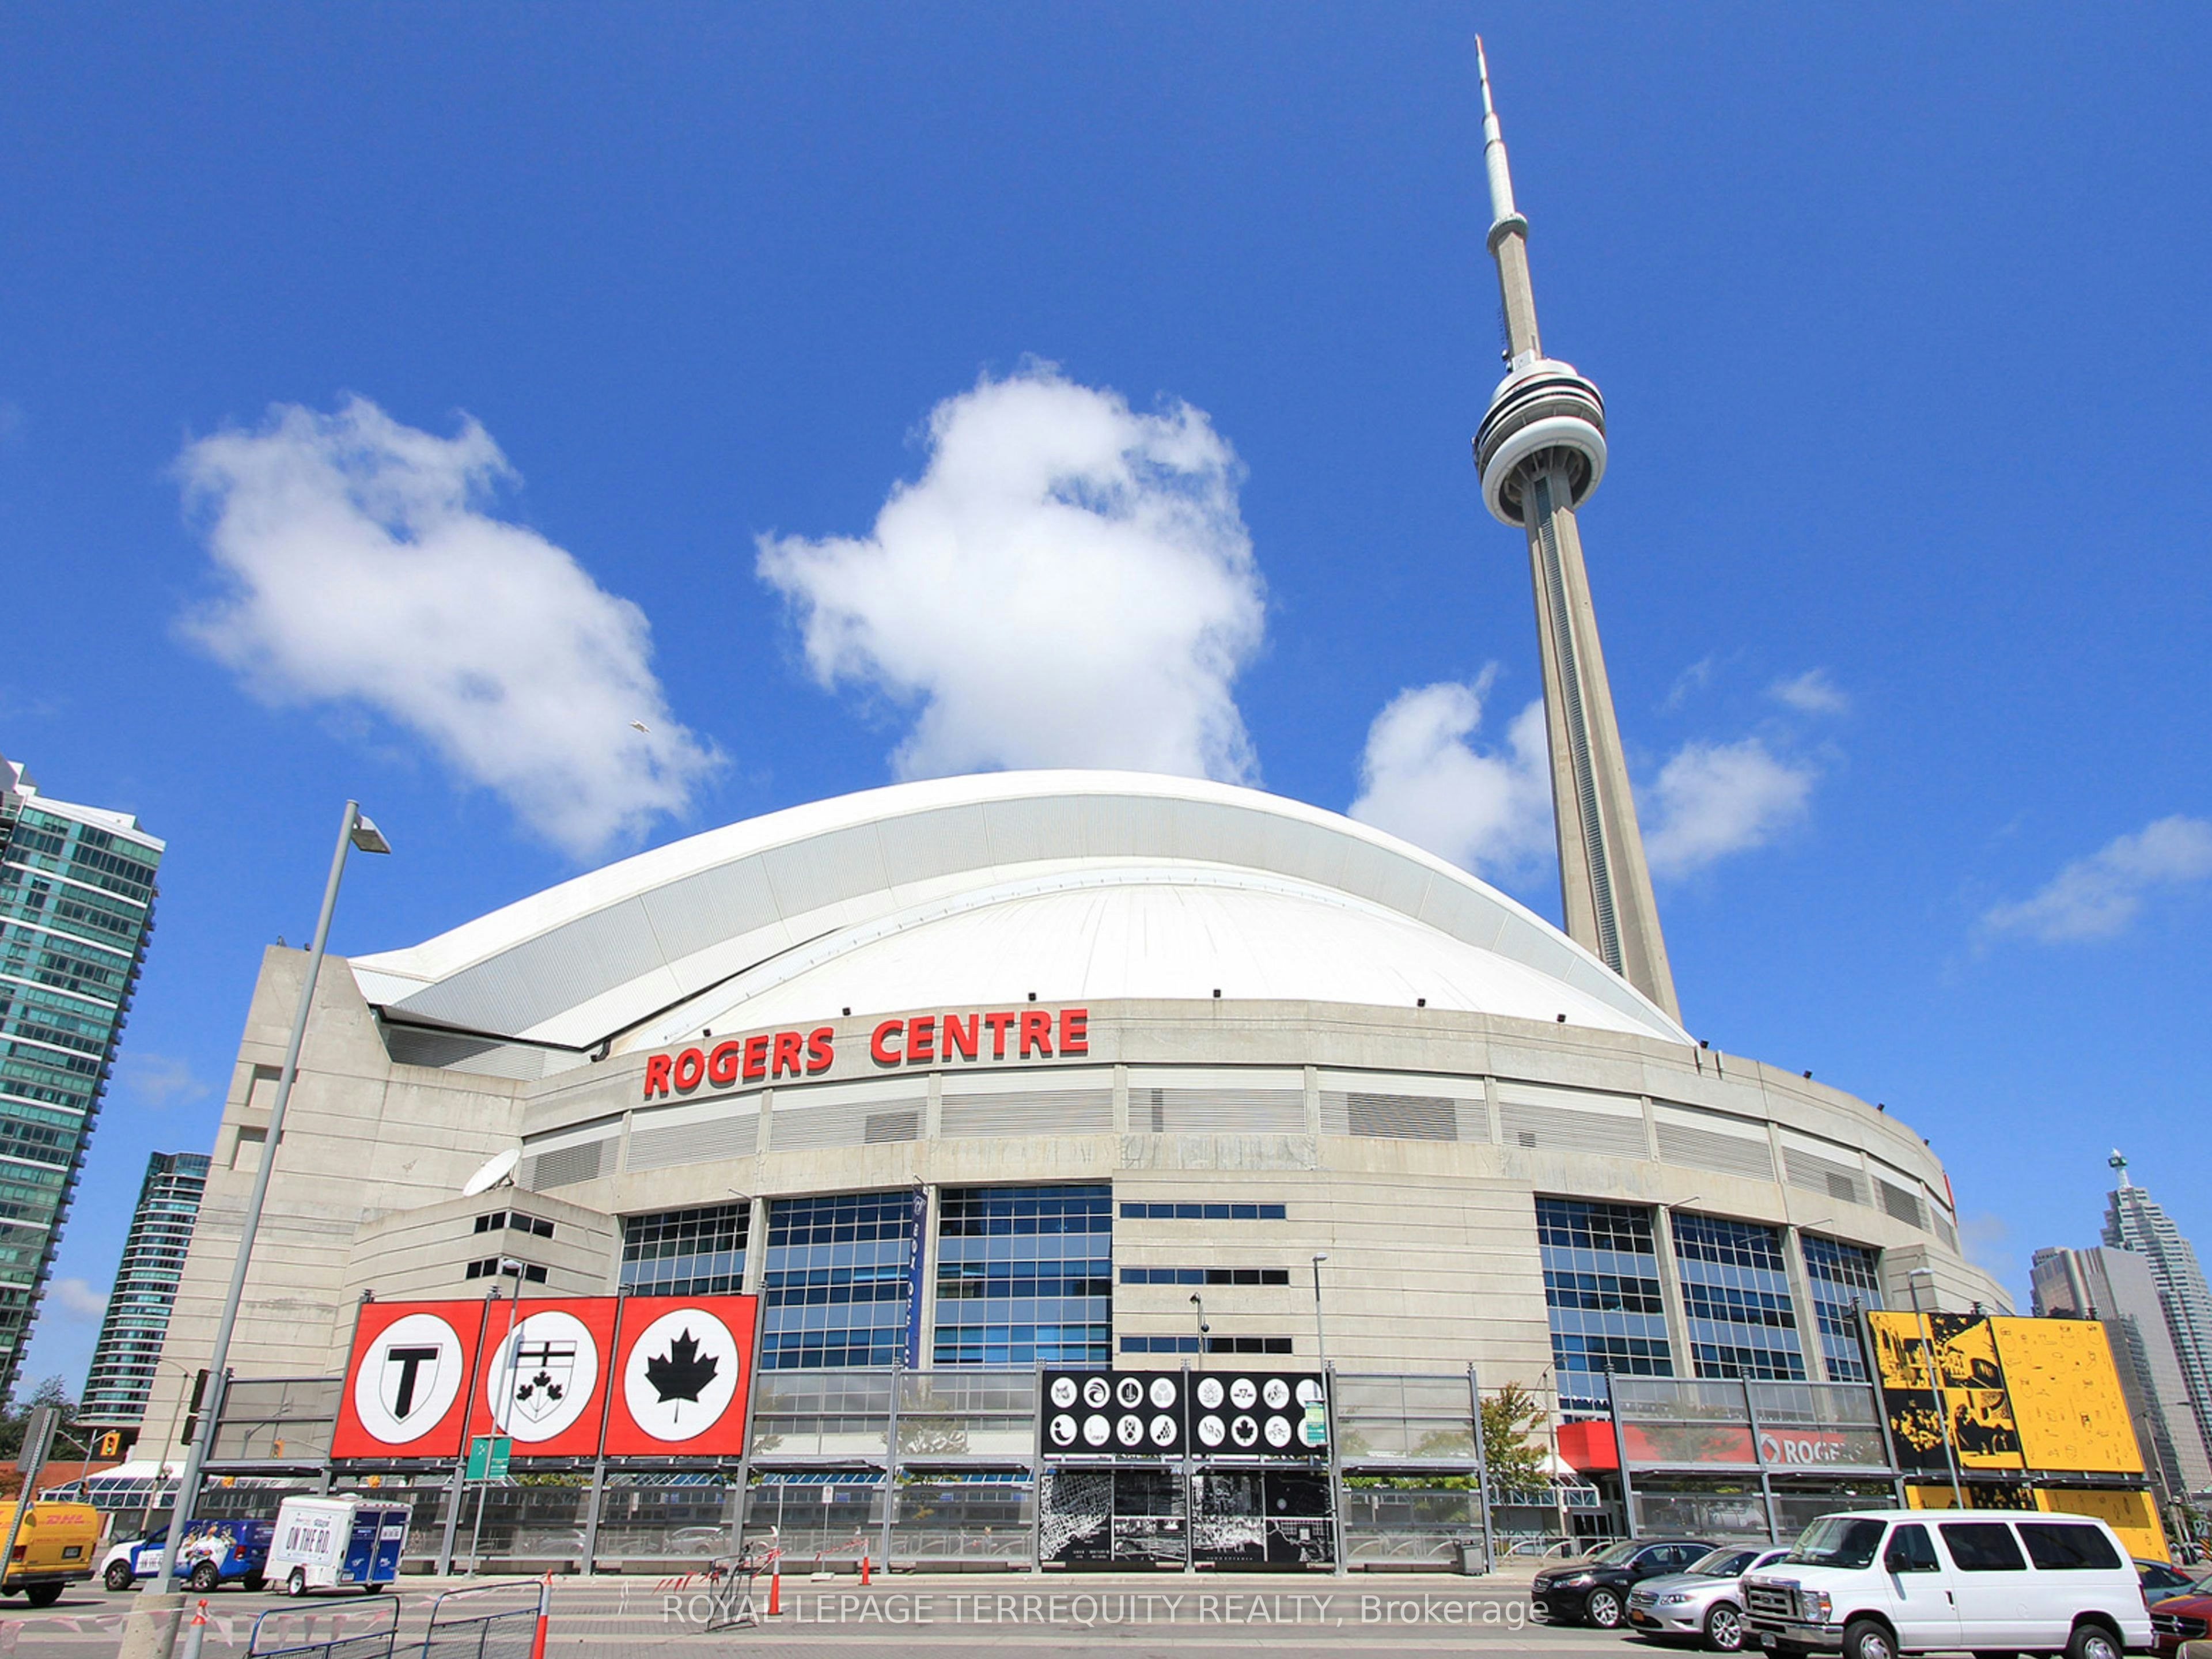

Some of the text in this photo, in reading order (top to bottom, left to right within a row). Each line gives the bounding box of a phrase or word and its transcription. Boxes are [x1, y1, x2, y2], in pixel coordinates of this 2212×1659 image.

[643, 1008, 1089, 1100] ROGERS CENTRE
[910, 1222, 919, 1271] BOX
[388, 1347, 439, 1419] T
[47, 1514, 85, 1525] DHL
[286, 1526, 301, 1550] ON
[299, 1528, 317, 1552] THE
